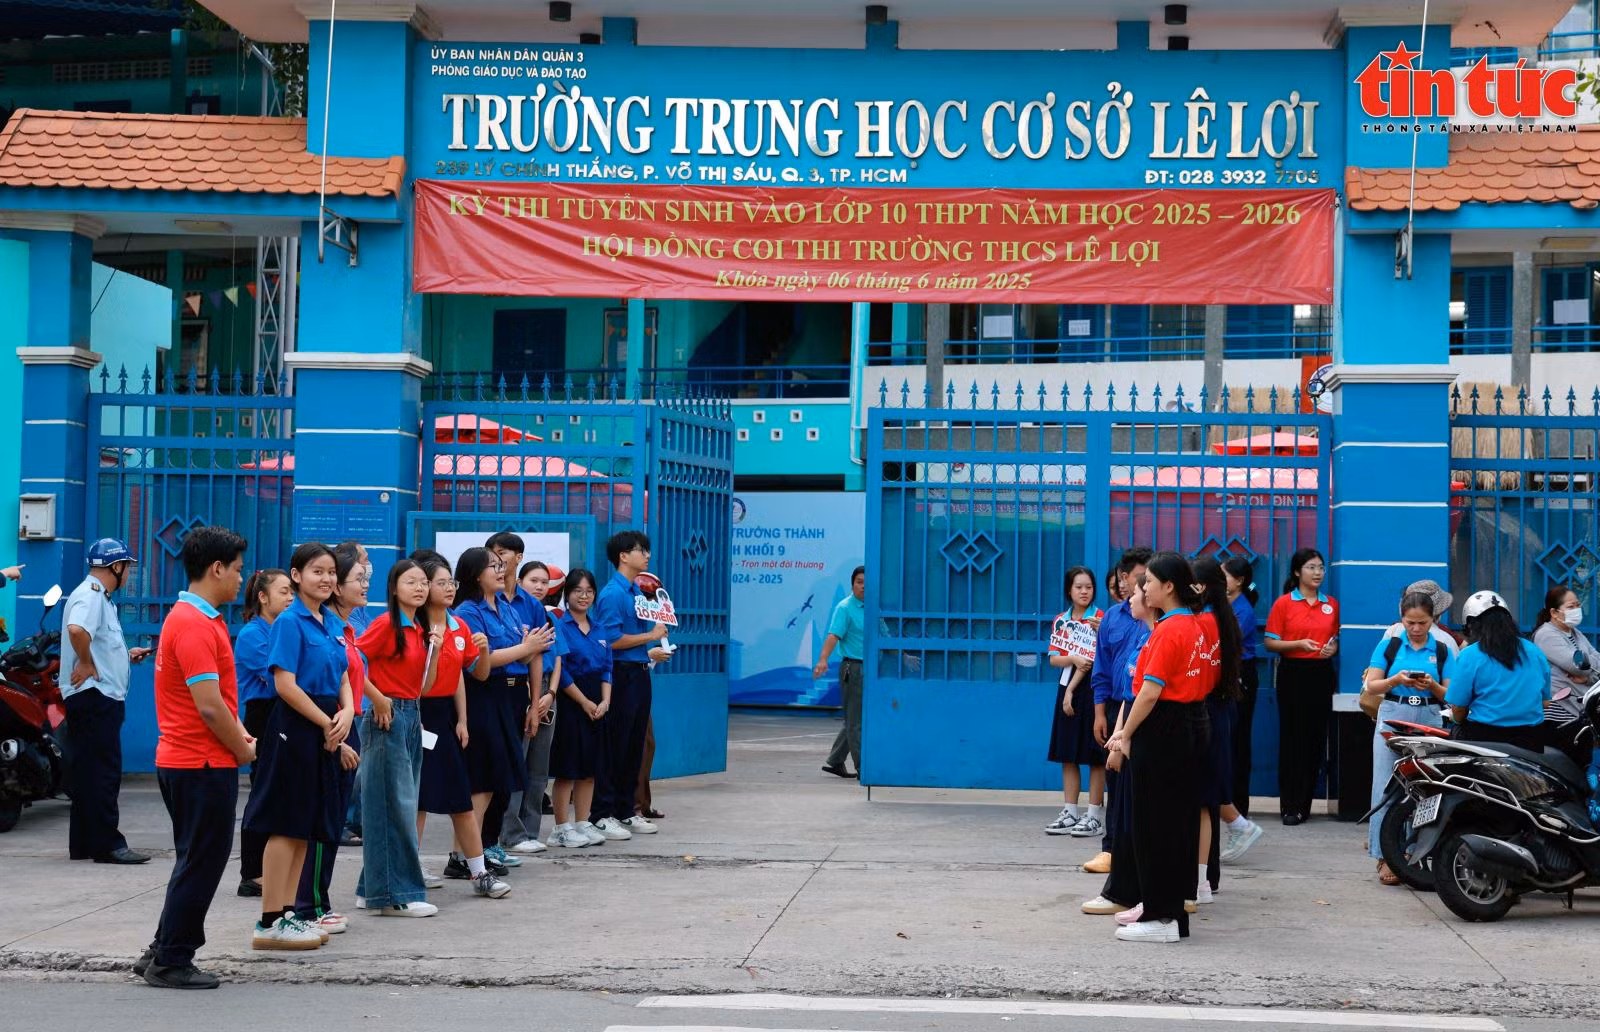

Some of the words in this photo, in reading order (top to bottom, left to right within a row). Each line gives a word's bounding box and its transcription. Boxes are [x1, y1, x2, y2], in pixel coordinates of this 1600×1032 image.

[431, 45, 447, 60] ỦY
[451, 49, 474, 60] BAN
[479, 48, 510, 61] NHÂN
[514, 48, 538, 61] DÂN
[542, 49, 573, 63] QUẬN
[577, 52, 584, 63] 3
[431, 62, 470, 76] PHÒNG
[473, 63, 498, 77] GIÁO
[501, 66, 523, 80] DỤC
[526, 65, 539, 78] VÀ
[541, 65, 563, 78] ĐÀO
[565, 68, 587, 81] TẠO
[442, 80, 655, 154] TRƯỜNG
[665, 98, 844, 158] TRUNG
[854, 99, 968, 169] HỌC
[981, 91, 1056, 160] CƠ
[1064, 81, 1134, 160] SỞ
[1148, 87, 1218, 160] LÊ
[1226, 90, 1320, 168] LỢI
[474, 157, 496, 176] LÝ
[500, 158, 559, 177] CHÍNH
[566, 156, 639, 181] THẮNG,
[643, 166, 659, 179] P.
[665, 161, 692, 180] VÕ
[699, 166, 727, 184] THỊ
[732, 162, 777, 184] SÁU,
[782, 168, 804, 182] Q.
[808, 168, 825, 184] 3,
[830, 168, 855, 182] TP.
[860, 169, 907, 183] HCM
[1145, 170, 1174, 184] ĐT:
[1178, 170, 1215, 184] 028
[1220, 170, 1266, 184] 3932
[449, 189, 490, 217] KỲ
[498, 196, 551, 219] THI
[665, 200, 735, 223] SINH
[742, 195, 807, 224] VÀO
[814, 196, 872, 224] LỚP
[880, 202, 907, 224] 10
[914, 203, 993, 225] THPT
[1000, 198, 1068, 225] NĂM
[1077, 202, 1144, 231] HỌC
[1152, 203, 1211, 225] 2025
[1241, 203, 1301, 225] 2026
[583, 233, 635, 263] HỘI
[642, 231, 725, 260] ĐỒNG
[733, 238, 785, 260] COI
[791, 239, 841, 261] THI
[849, 234, 973, 262] TRƯỜNG
[980, 240, 1057, 263] THCS
[1064, 235, 1101, 263] LÊ
[1108, 239, 1160, 268] LỢI
[715, 269, 767, 288] Khóa
[774, 271, 822, 292] ngày
[827, 271, 851, 289] 06
[856, 272, 912, 294] tháng
[917, 272, 929, 290] 6
[934, 271, 978, 290] năm
[984, 271, 1033, 290] 2025
[784, 525, 825, 539] THÀNH
[744, 542, 775, 556] KHỐI
[778, 545, 785, 556] 9
[741, 560, 759, 569] Trọn
[762, 560, 777, 569] một
[732, 574, 750, 584] 024
[758, 574, 783, 584] 2025
[1051, 635, 1064, 647] THI
